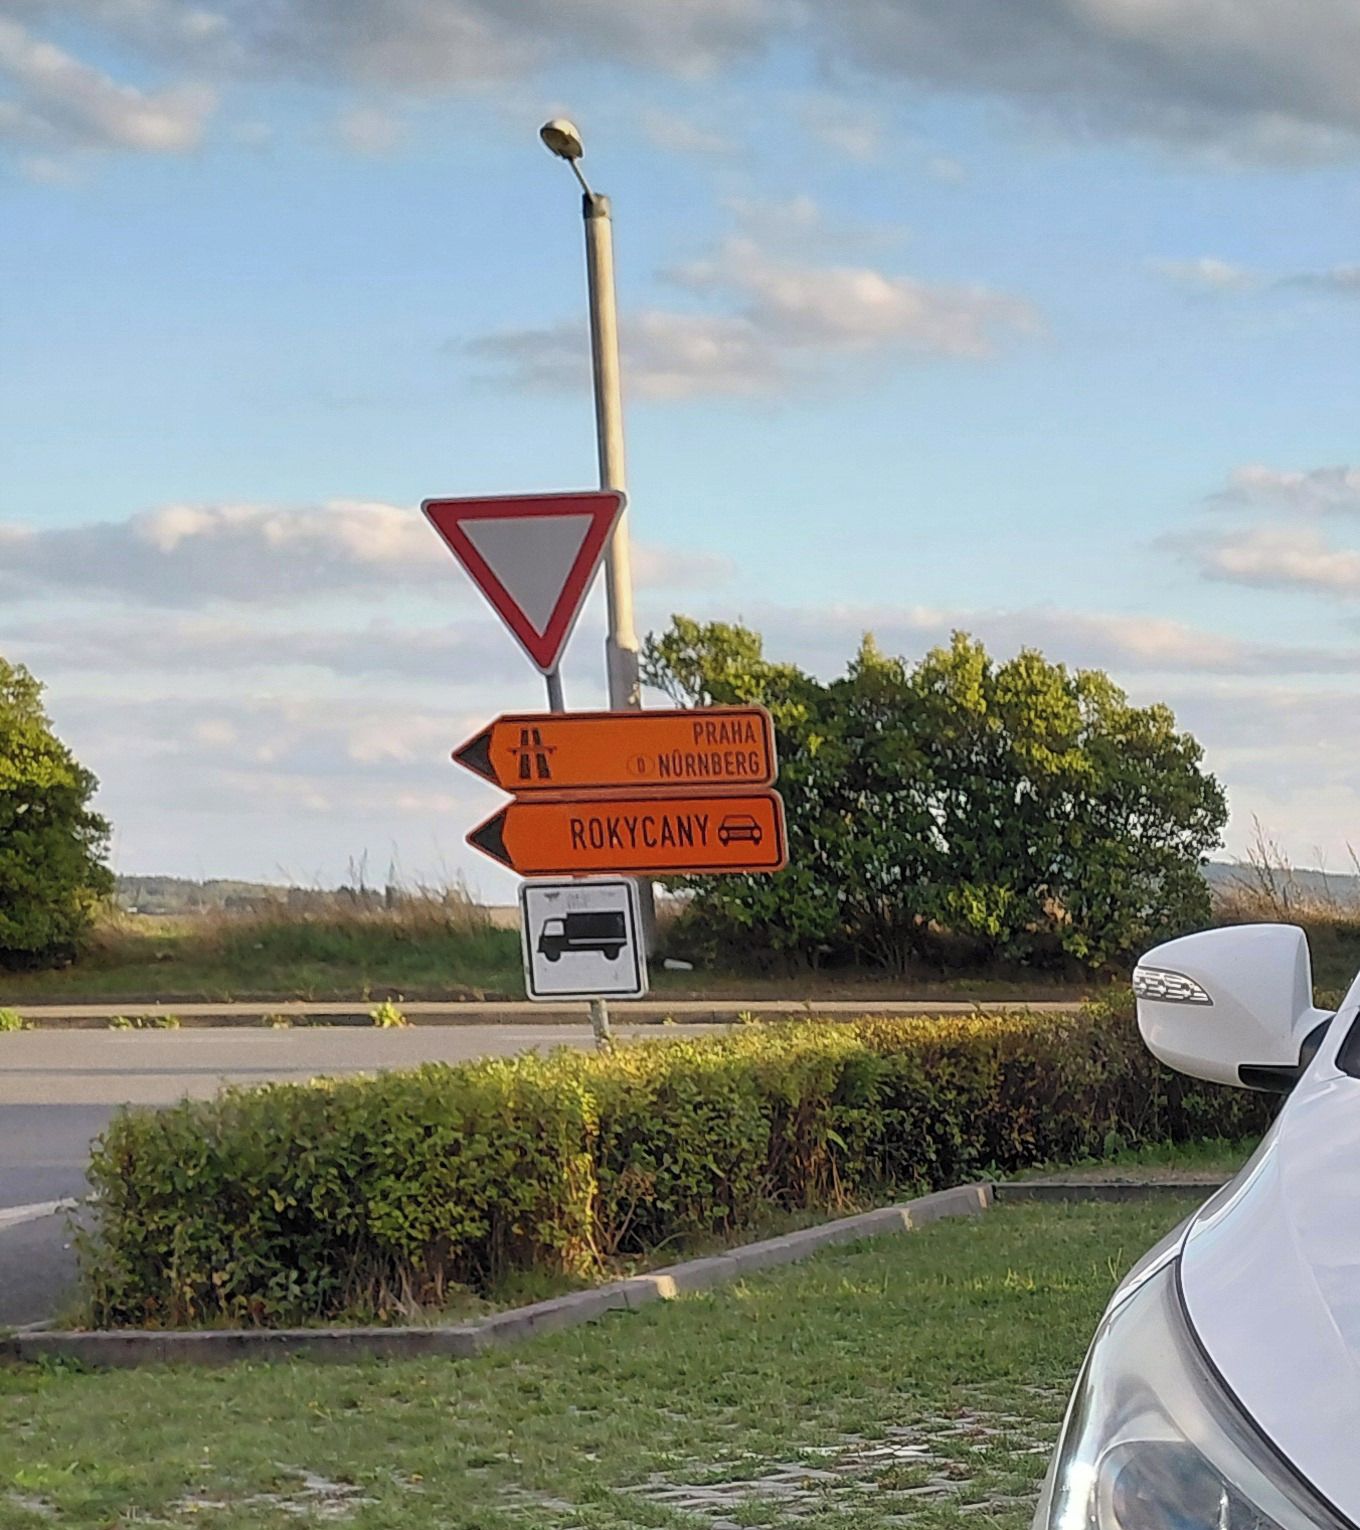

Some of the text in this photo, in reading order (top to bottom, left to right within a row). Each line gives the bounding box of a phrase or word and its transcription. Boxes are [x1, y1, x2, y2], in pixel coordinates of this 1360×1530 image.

[693, 721, 757, 746] PRAHA
[658, 749, 759, 777] NÜRNBERG
[570, 814, 709, 850] ROKYCANY
